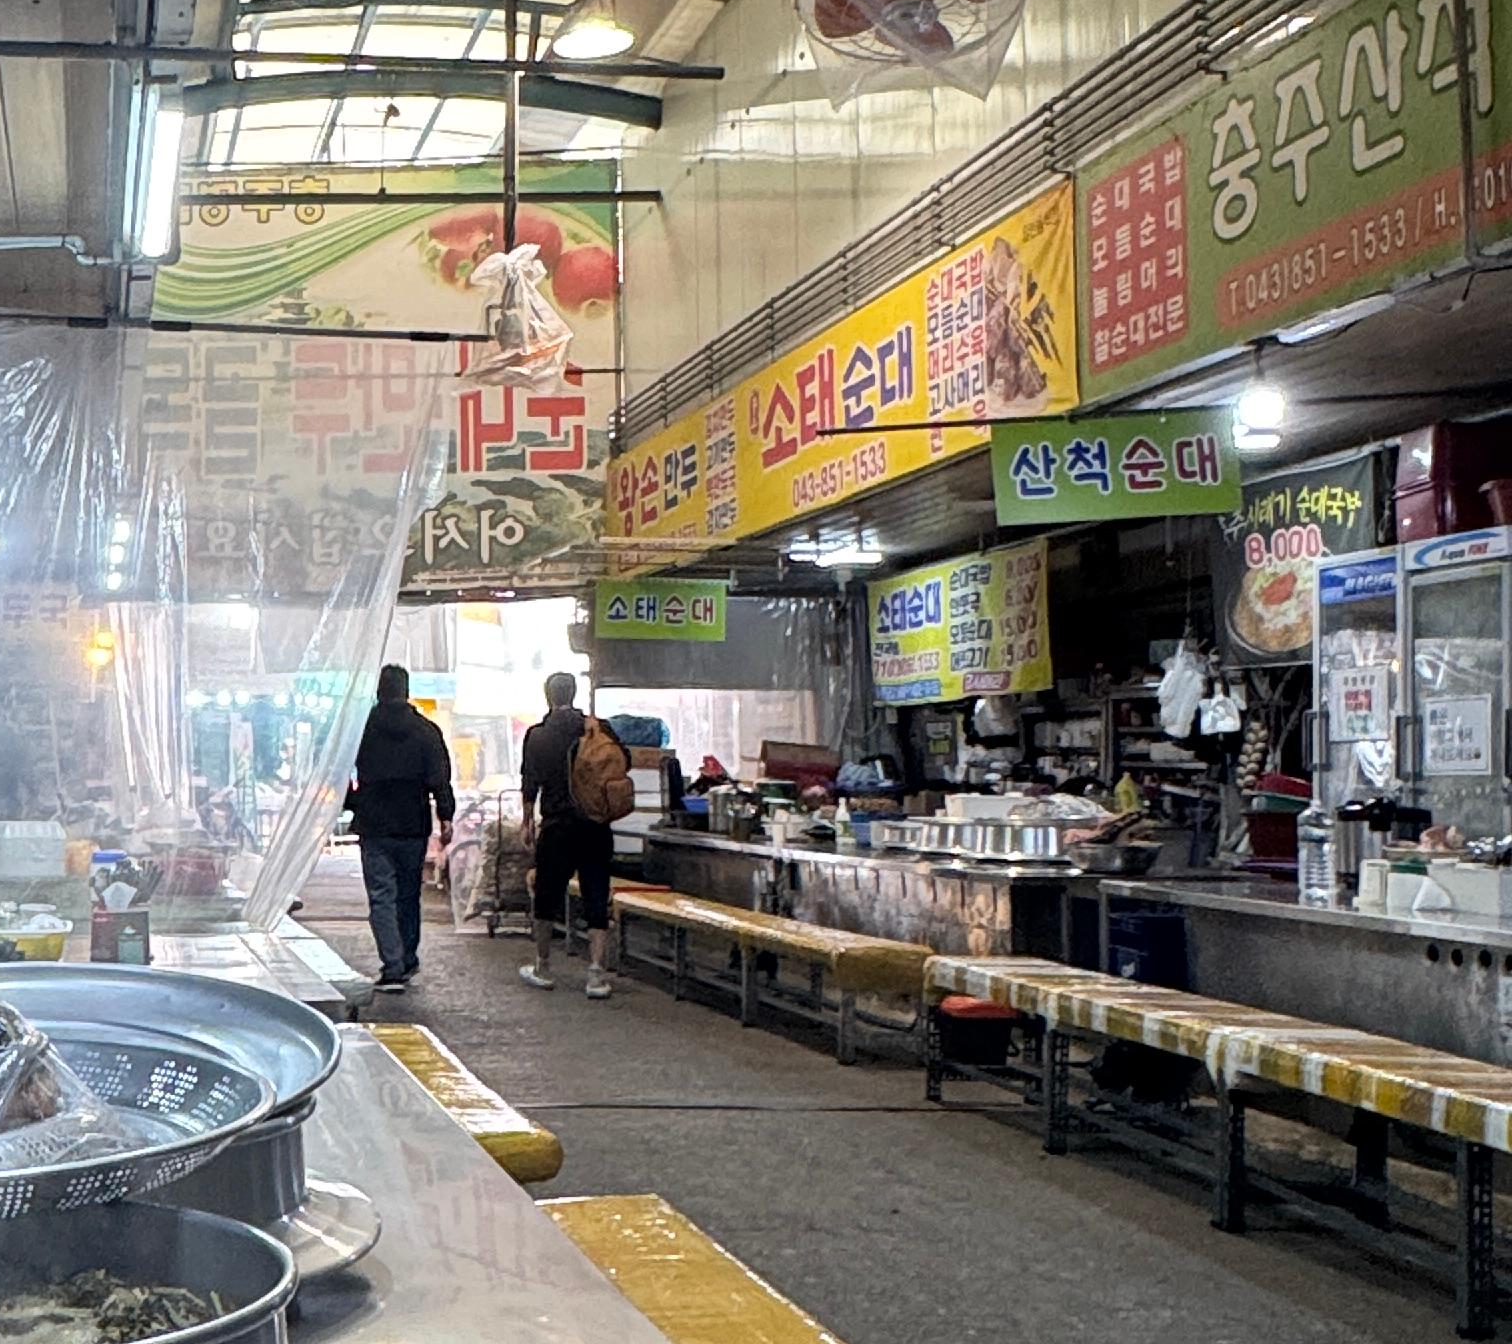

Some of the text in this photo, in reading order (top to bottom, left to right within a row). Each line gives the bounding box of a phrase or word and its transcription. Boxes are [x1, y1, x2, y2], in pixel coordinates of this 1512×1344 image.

[1092, 146, 1182, 227] 순대국밥
[1092, 195, 1182, 273] 모듬순대
[927, 250, 984, 312] 순대국밥
[927, 286, 983, 346] 모듬순대
[928, 324, 984, 381] 머리수육
[929, 361, 984, 416] 고사머리
[793, 441, 886, 508] 043-851-1533
[1011, 434, 1221, 498] 산척순대
[1245, 523, 1322, 568] 8,000
[607, 592, 716, 626] 소태순대
[876, 580, 941, 634] 소태순대
